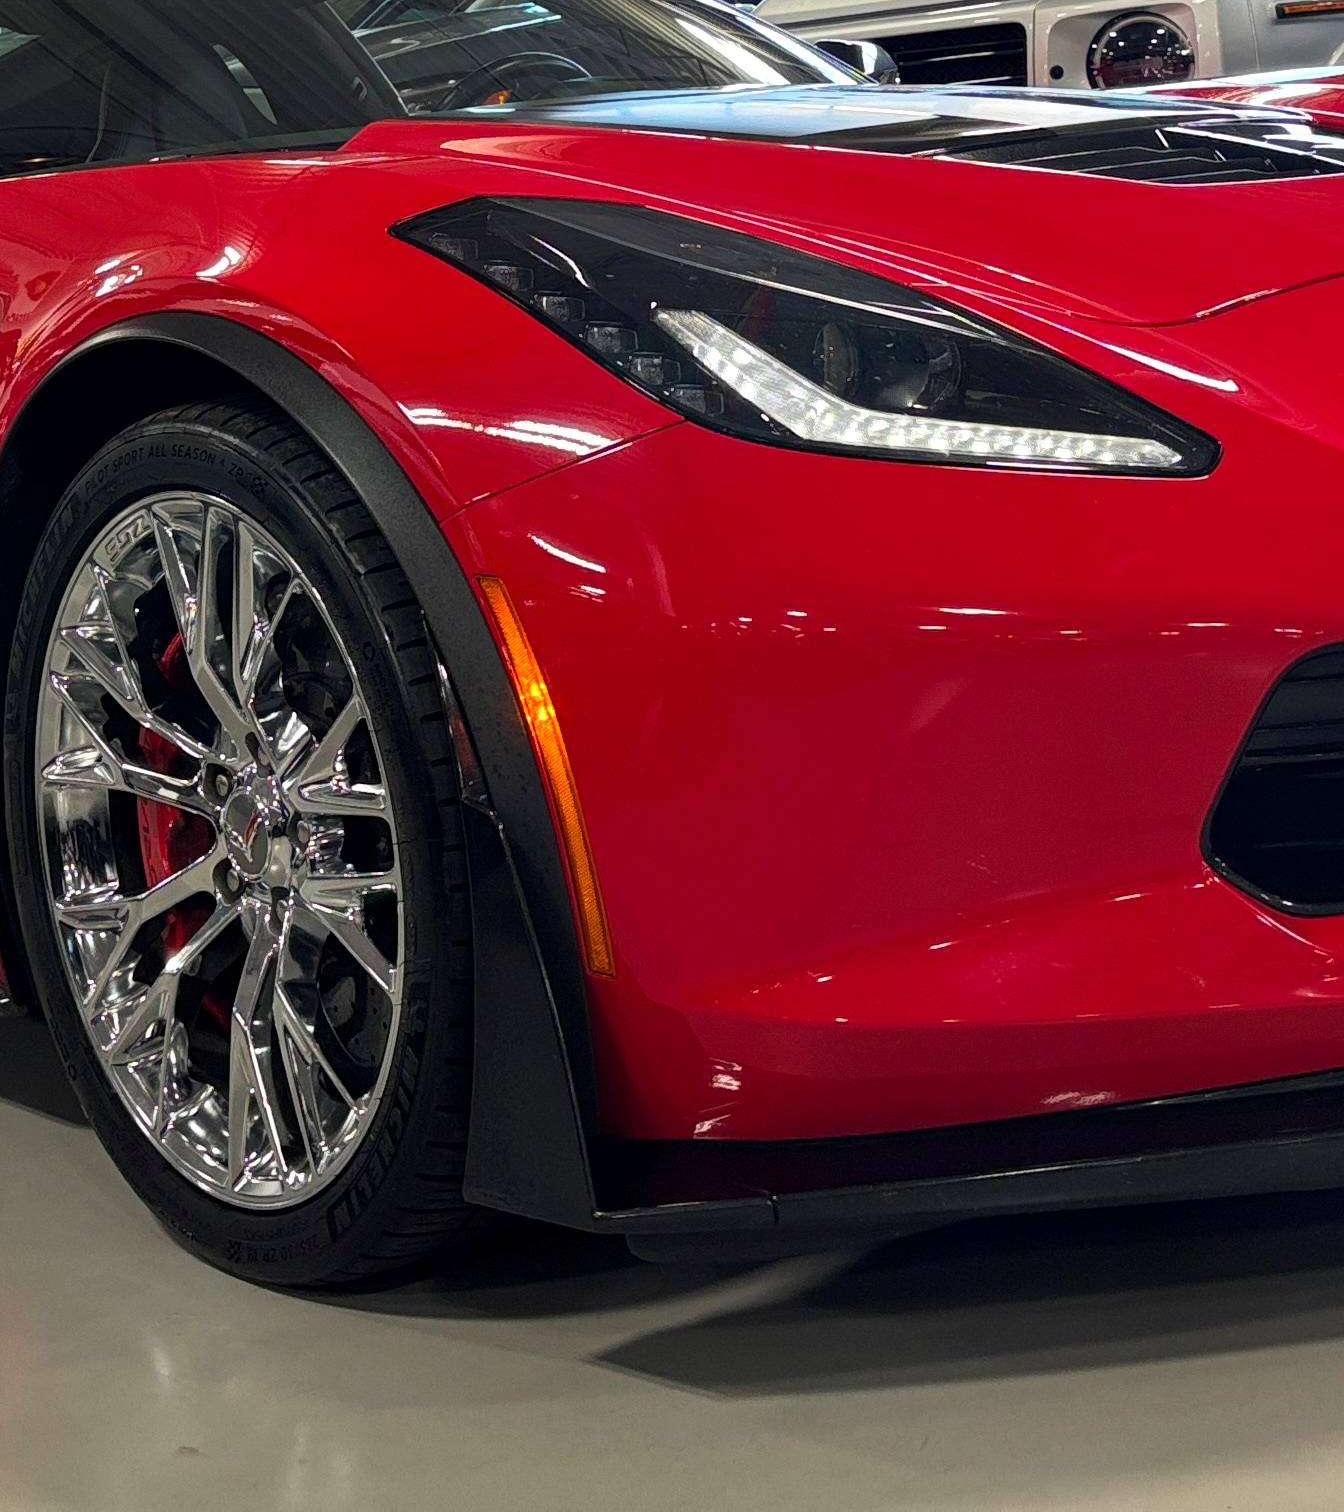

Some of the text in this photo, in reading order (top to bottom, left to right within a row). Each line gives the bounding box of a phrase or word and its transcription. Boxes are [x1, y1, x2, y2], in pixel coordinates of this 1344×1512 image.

[112, 446, 145, 473] SPORT
[148, 445, 167, 458] ALL
[171, 445, 217, 466] SEASON
